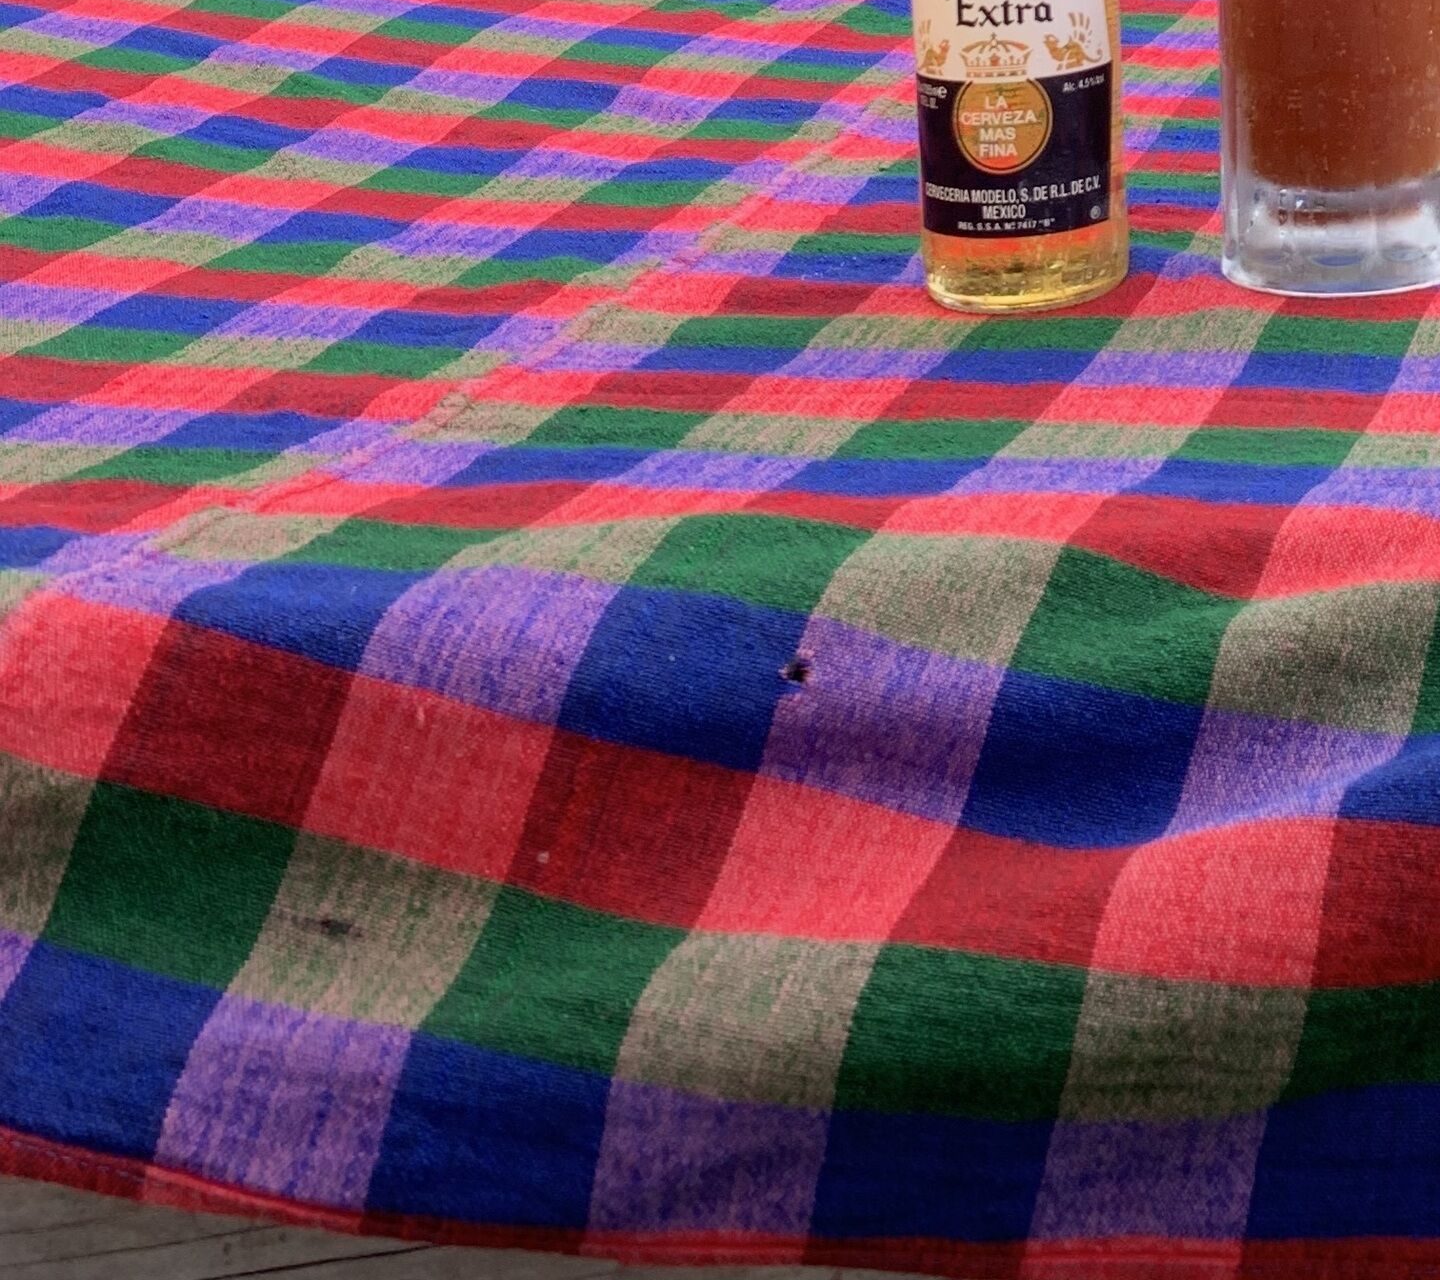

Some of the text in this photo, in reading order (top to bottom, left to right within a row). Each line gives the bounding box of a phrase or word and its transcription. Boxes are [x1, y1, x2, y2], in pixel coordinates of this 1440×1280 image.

[984, 96, 1009, 110] LA
[960, 109, 1038, 126] CERVEZA
[979, 127, 1017, 142] MAS
[979, 143, 1019, 157] FINA
[925, 174, 1101, 204] CERVECERIA MODELO, S. DE R.L. DE C.V.
[982, 204, 1026, 219] MEXICO
